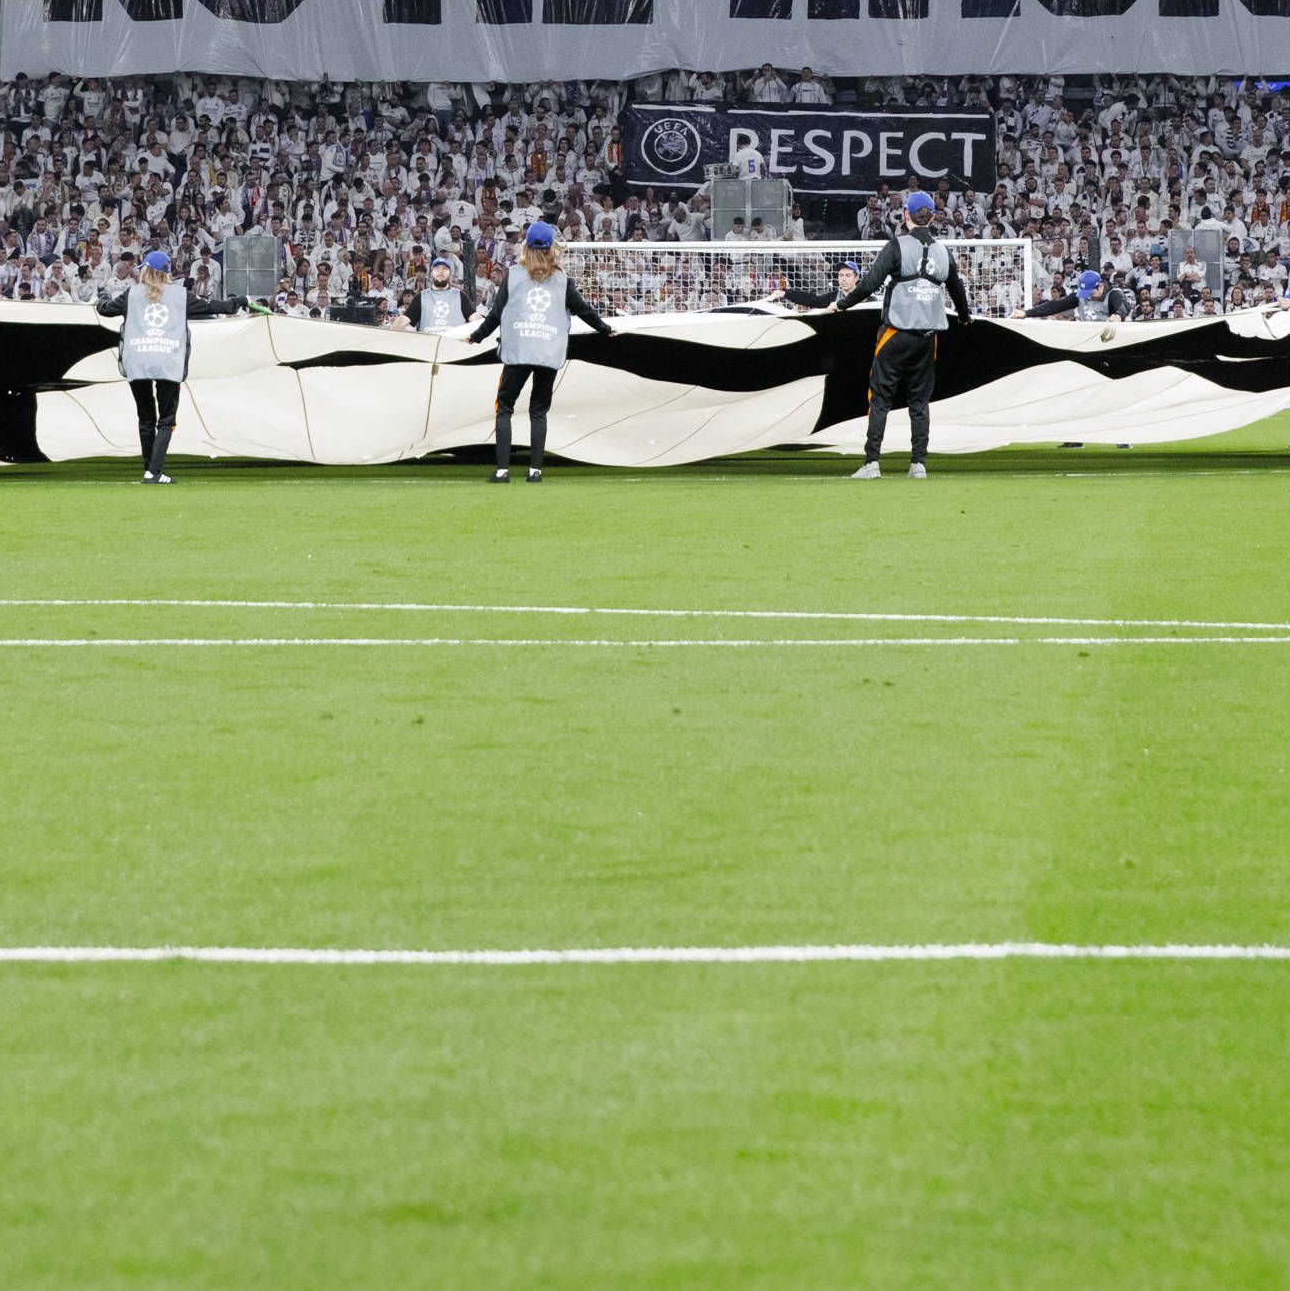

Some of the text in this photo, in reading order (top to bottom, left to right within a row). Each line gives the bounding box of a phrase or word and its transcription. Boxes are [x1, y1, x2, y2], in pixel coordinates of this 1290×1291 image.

[654, 122, 688, 136] UEFA
[748, 159, 756, 174] 5
[513, 321, 558, 335] CHAMPIONS
[130, 336, 180, 348] CHAMPIONS
